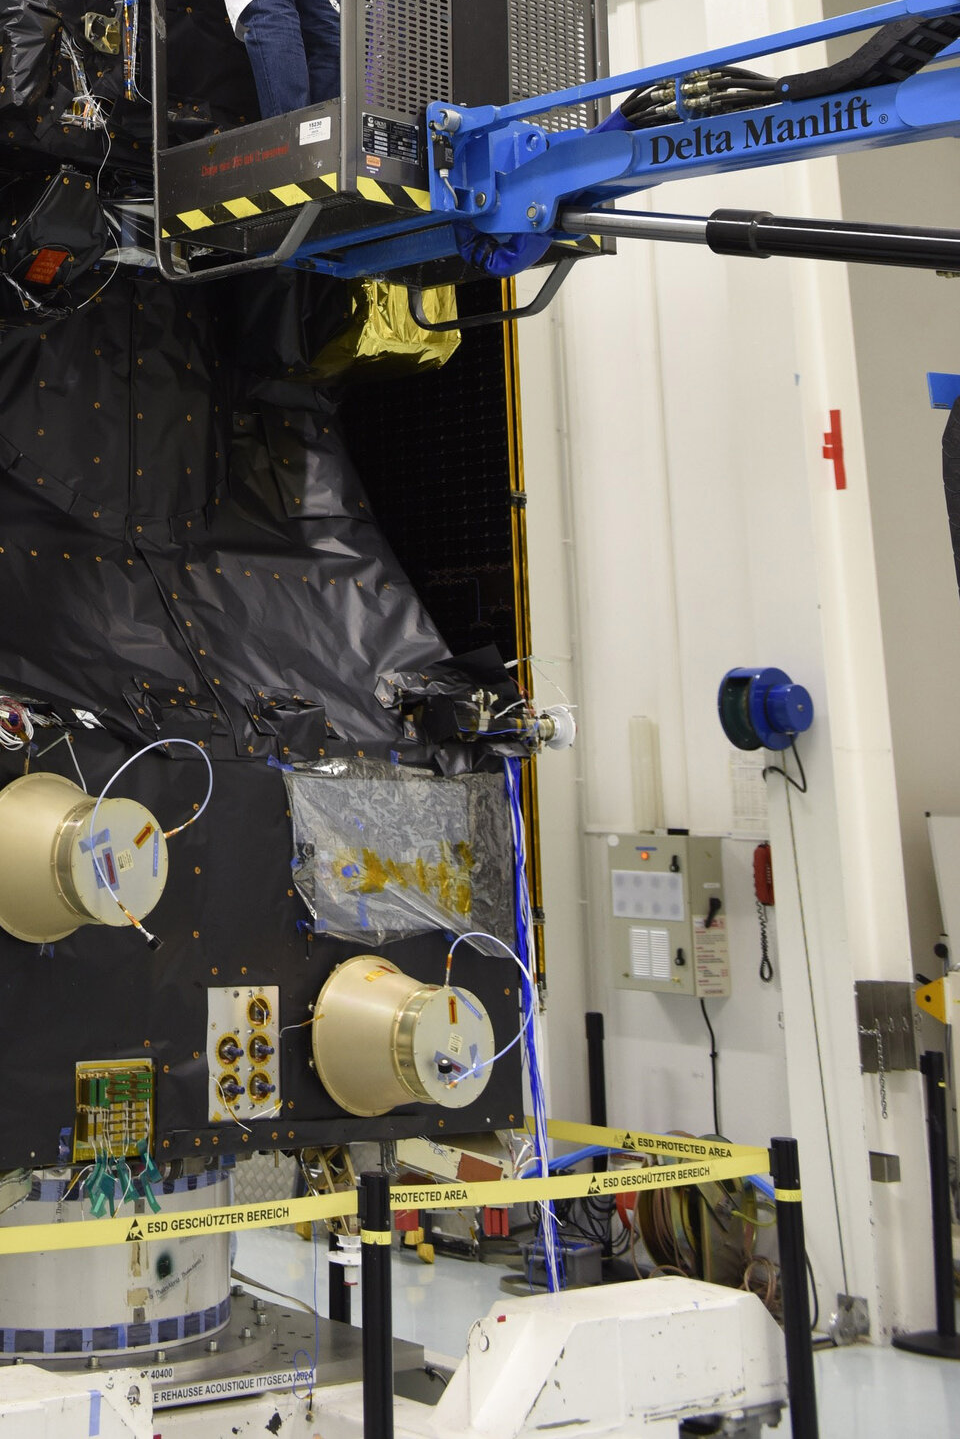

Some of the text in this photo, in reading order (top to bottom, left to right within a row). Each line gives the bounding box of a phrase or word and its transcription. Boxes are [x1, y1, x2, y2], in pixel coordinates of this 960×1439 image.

[650, 96, 873, 165] Delta Manlift
[638, 1137, 653, 1148] ESD
[656, 1140, 706, 1155] PROTECTED
[708, 1147, 732, 1158] AREA
[603, 1166, 710, 1188] ESD GESCHÜTZTER BEREICH
[389, 1189, 468, 1203] PROTECTED AREA
[147, 1207, 290, 1233] ESD GESCHÜTZTER BEREICH
[151, 1368, 173, 1379] 40400
[161, 1386, 204, 1402] REHAUSSE
[205, 1378, 254, 1394] ACOUSTIQUE
